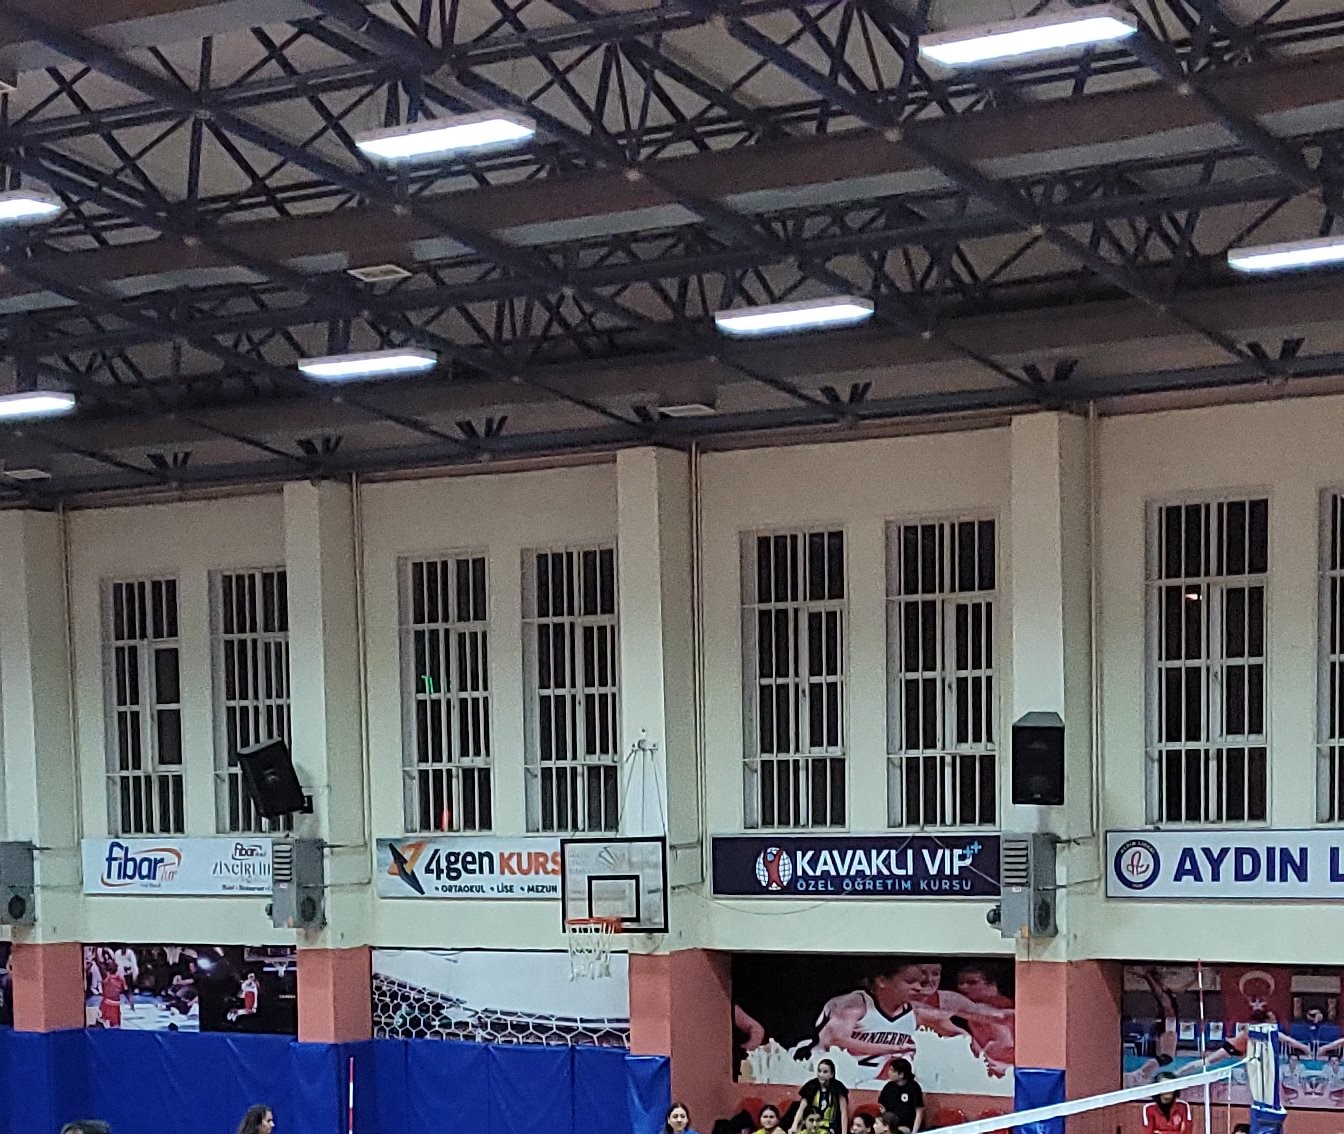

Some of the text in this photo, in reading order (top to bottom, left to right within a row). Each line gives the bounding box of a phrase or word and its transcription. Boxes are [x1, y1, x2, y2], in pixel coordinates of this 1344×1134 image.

[106, 841, 165, 881] fibar
[424, 848, 495, 881] 4gen
[796, 849, 914, 877] KAVAKLI
[1173, 846, 1309, 883] AYDIN
[441, 885, 486, 894] ORTAOKUL
[497, 884, 515, 894] LİSE
[797, 875, 973, 891] ÖZEL ÖĞRETİM KURSU
